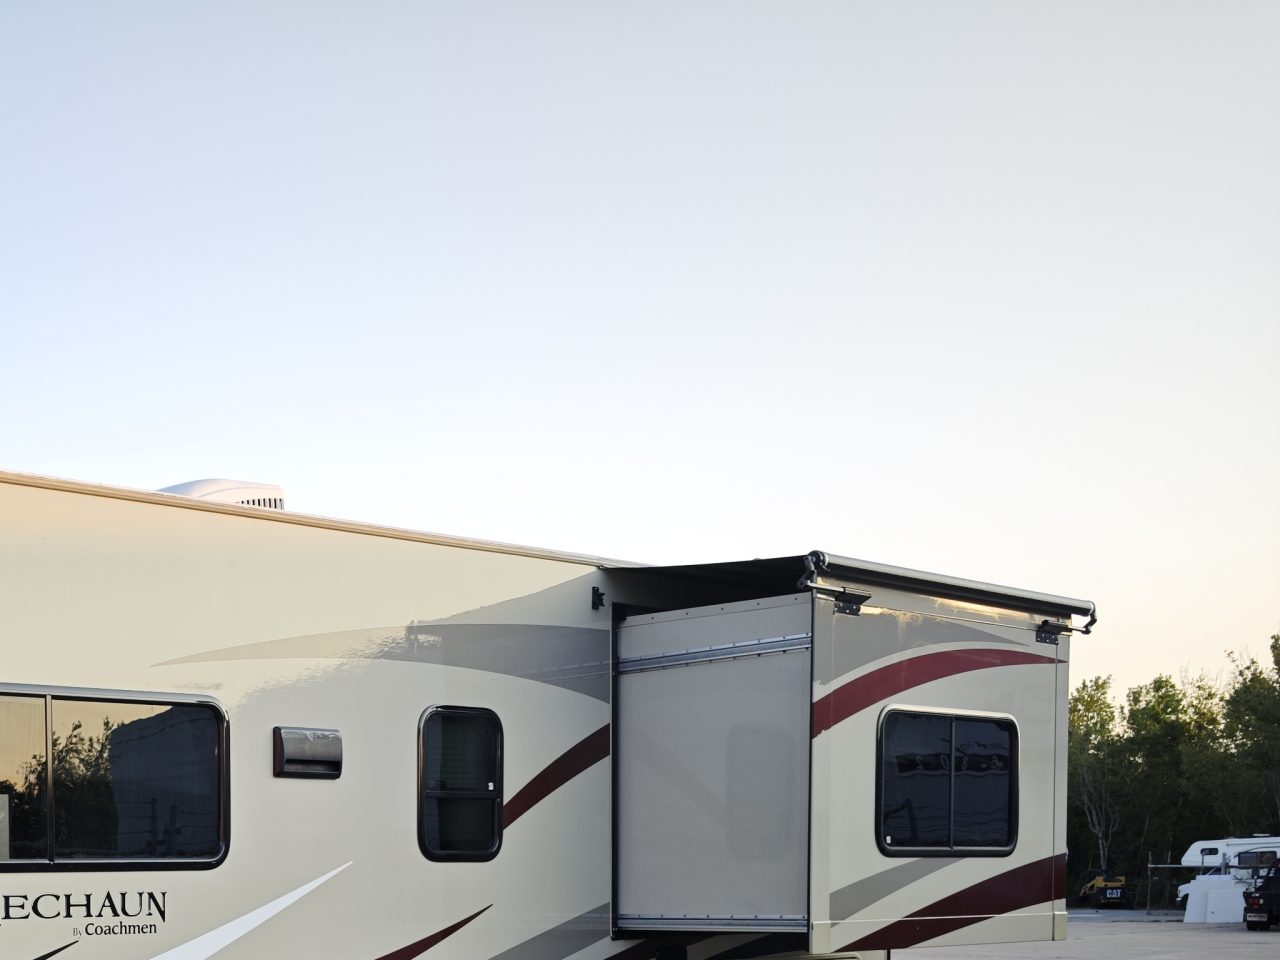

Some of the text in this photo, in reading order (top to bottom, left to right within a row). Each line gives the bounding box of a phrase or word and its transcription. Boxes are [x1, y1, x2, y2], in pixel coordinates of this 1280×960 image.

[1106, 889, 1122, 898] CAT
[72, 920, 158, 939] By Coachmen
